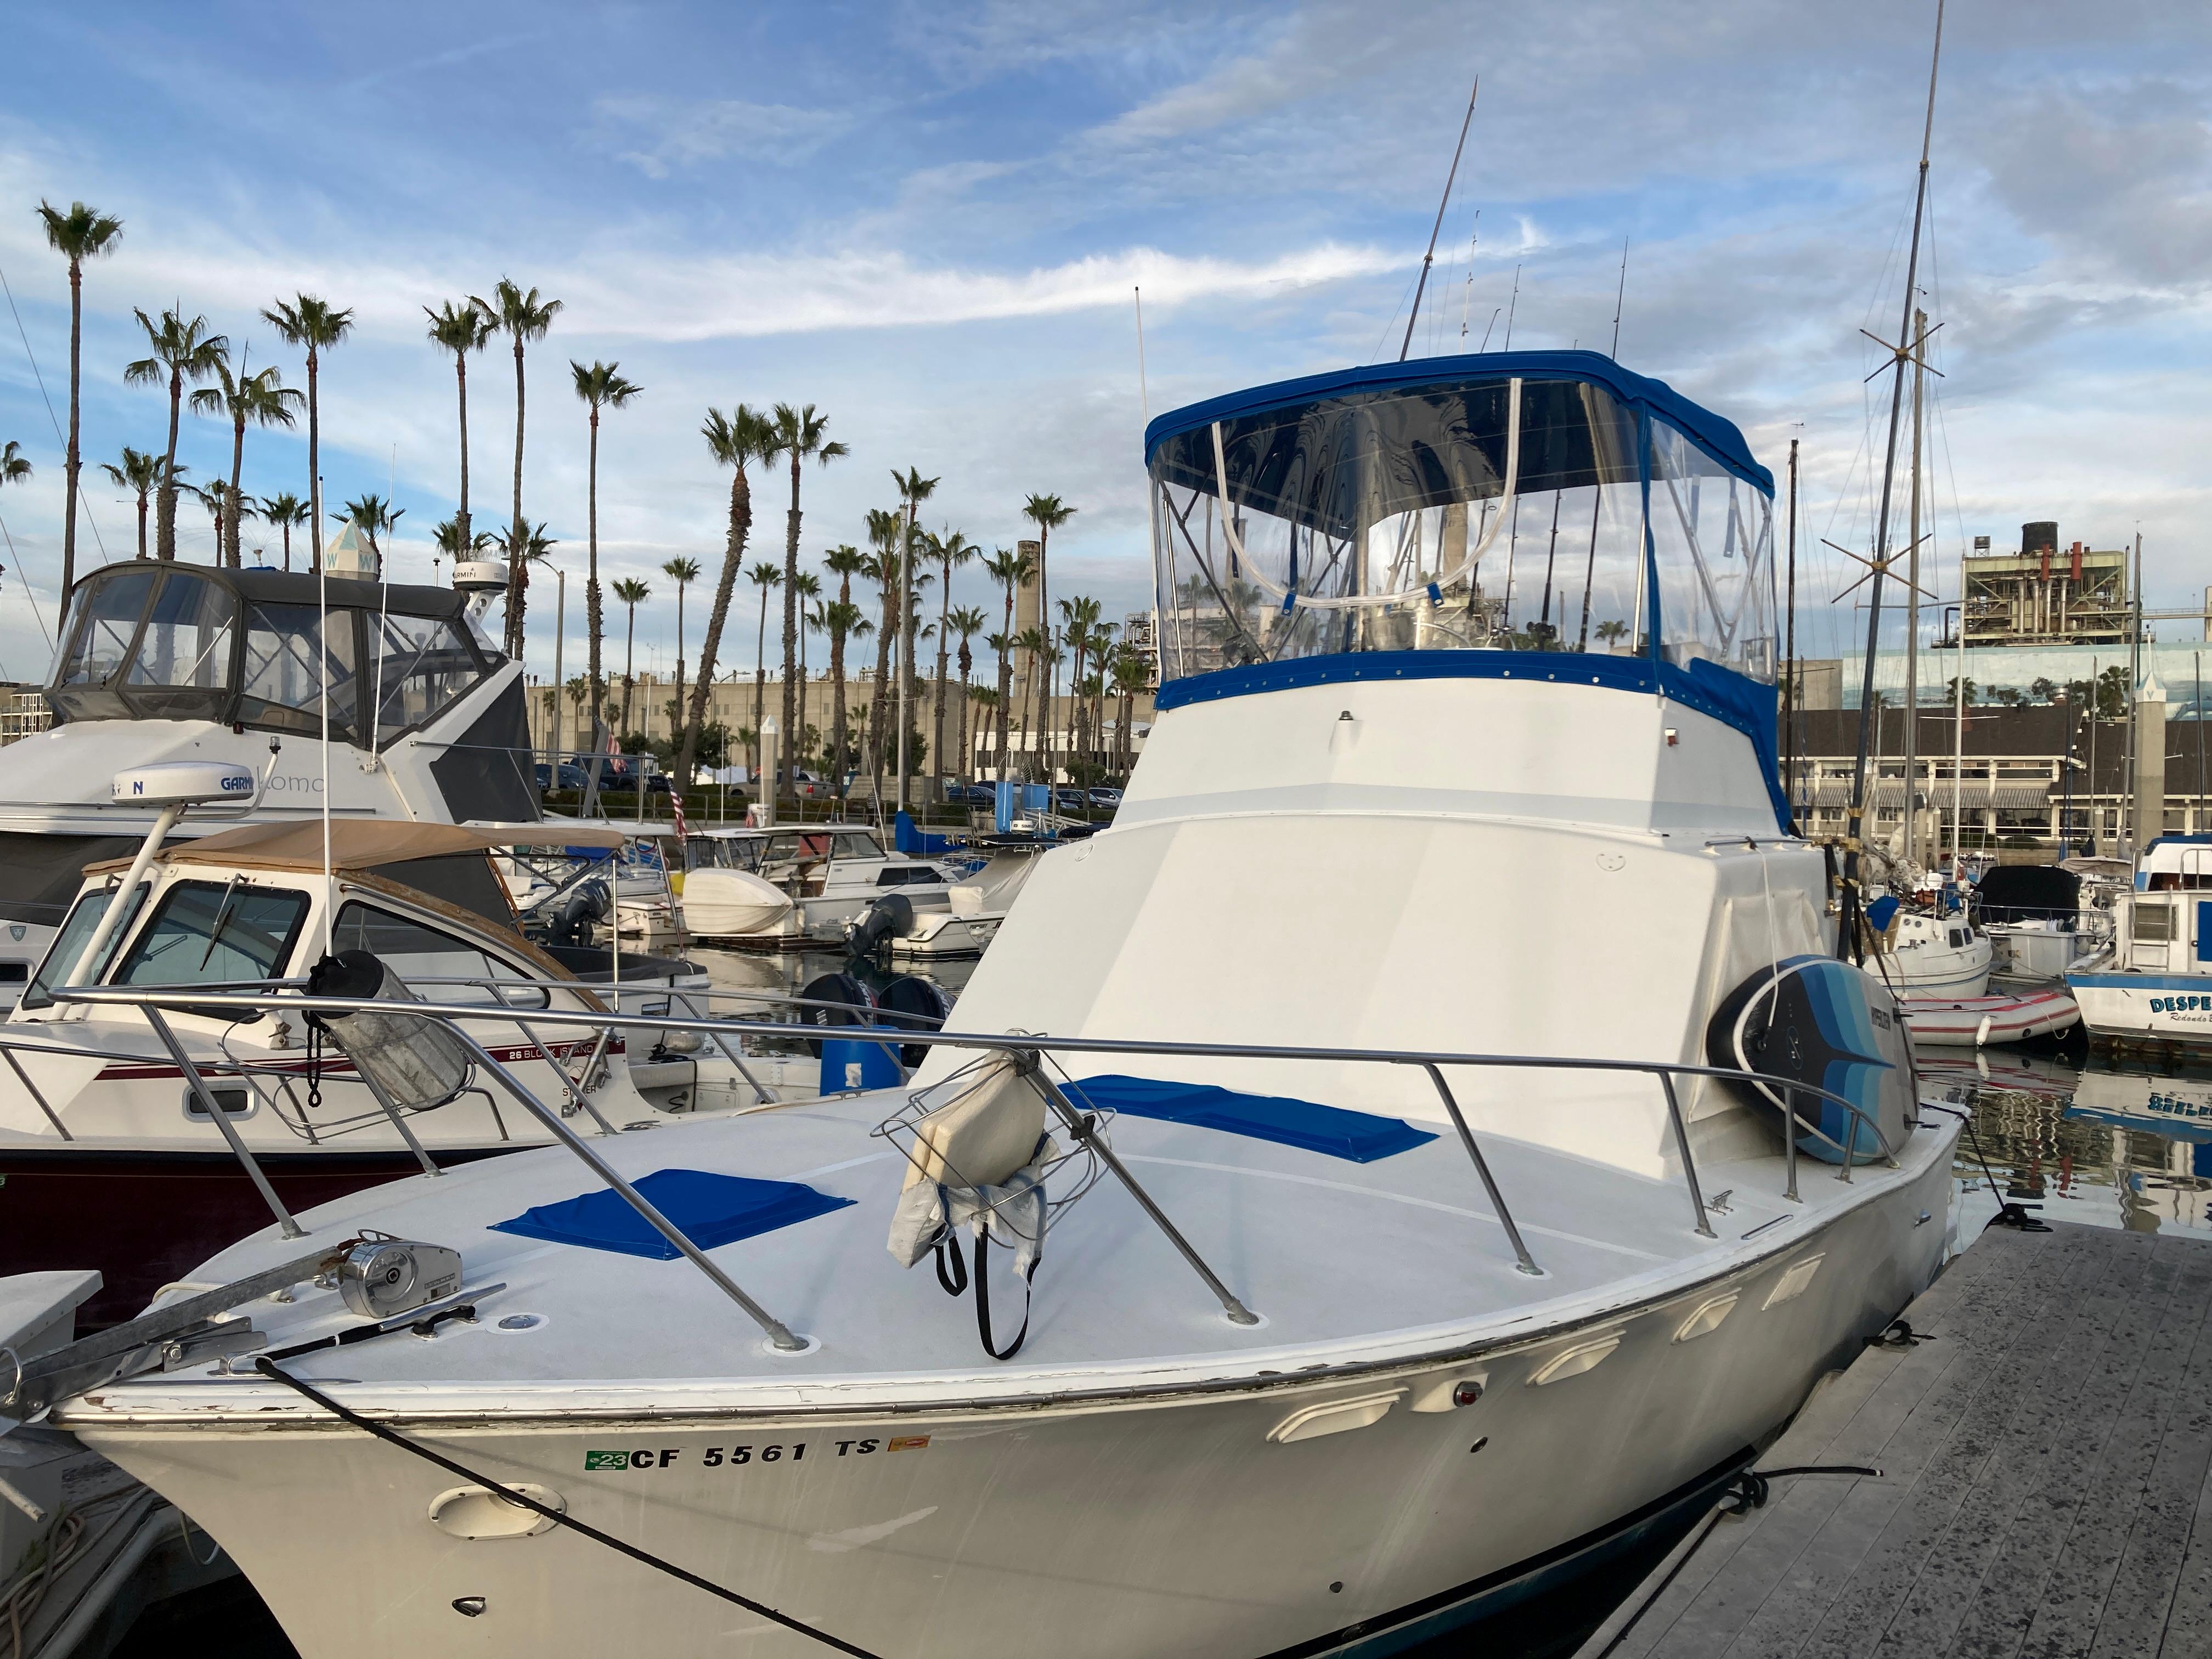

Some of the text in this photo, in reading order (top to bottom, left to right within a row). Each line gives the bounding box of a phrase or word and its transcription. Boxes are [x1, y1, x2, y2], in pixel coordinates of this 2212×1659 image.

[221, 776, 254, 791] GARM
[257, 766, 325, 793] komo
[509, 1051, 522, 1059] 26
[524, 1048, 558, 1058] BLOK
[563, 1085, 596, 1097] STER
[599, 1454, 627, 1466] 23
[630, 1438, 880, 1469] CF 5561 TS
